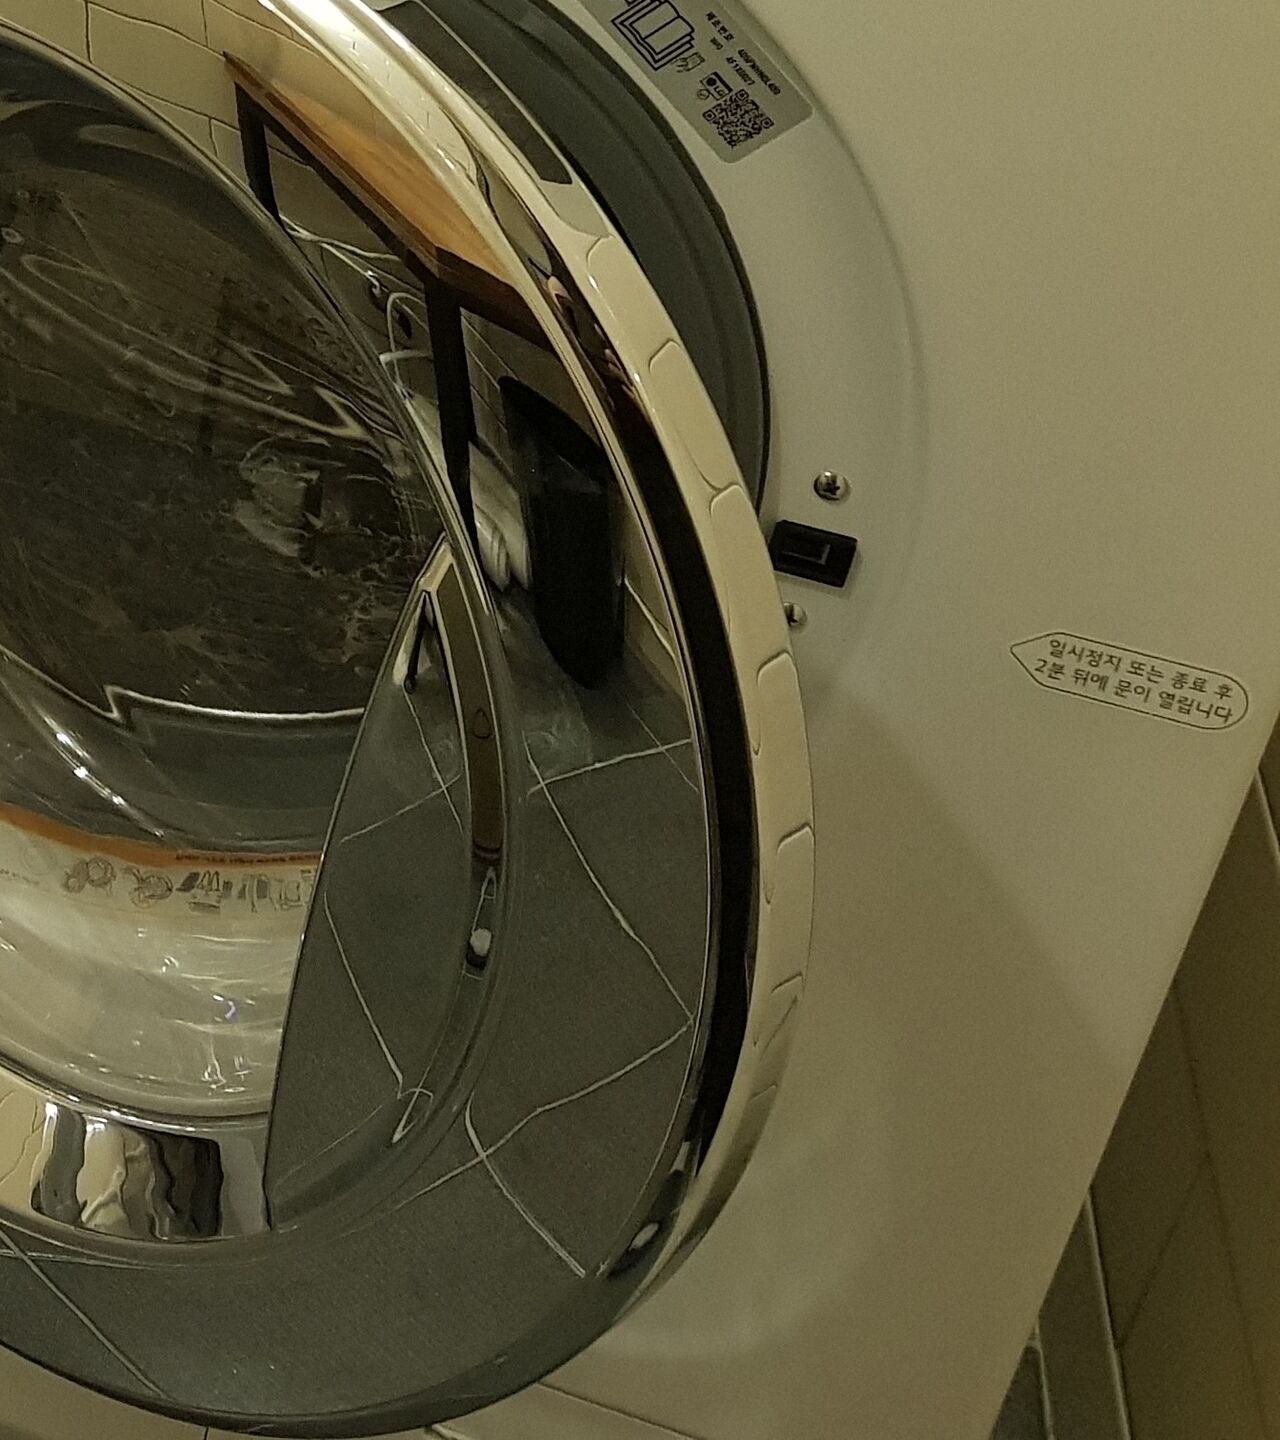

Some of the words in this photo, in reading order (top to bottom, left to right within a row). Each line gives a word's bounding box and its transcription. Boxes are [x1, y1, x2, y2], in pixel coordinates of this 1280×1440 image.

[1034, 658, 1065, 681] 2분
[1072, 669, 1110, 692] 뒤에
[1114, 679, 1151, 703] 문이
[1158, 690, 1233, 724] 열립니다
[1050, 639, 1122, 672] 일시정지
[1127, 660, 1164, 684] 또는
[1171, 671, 1208, 693] 종료
[1214, 683, 1233, 700] 후
